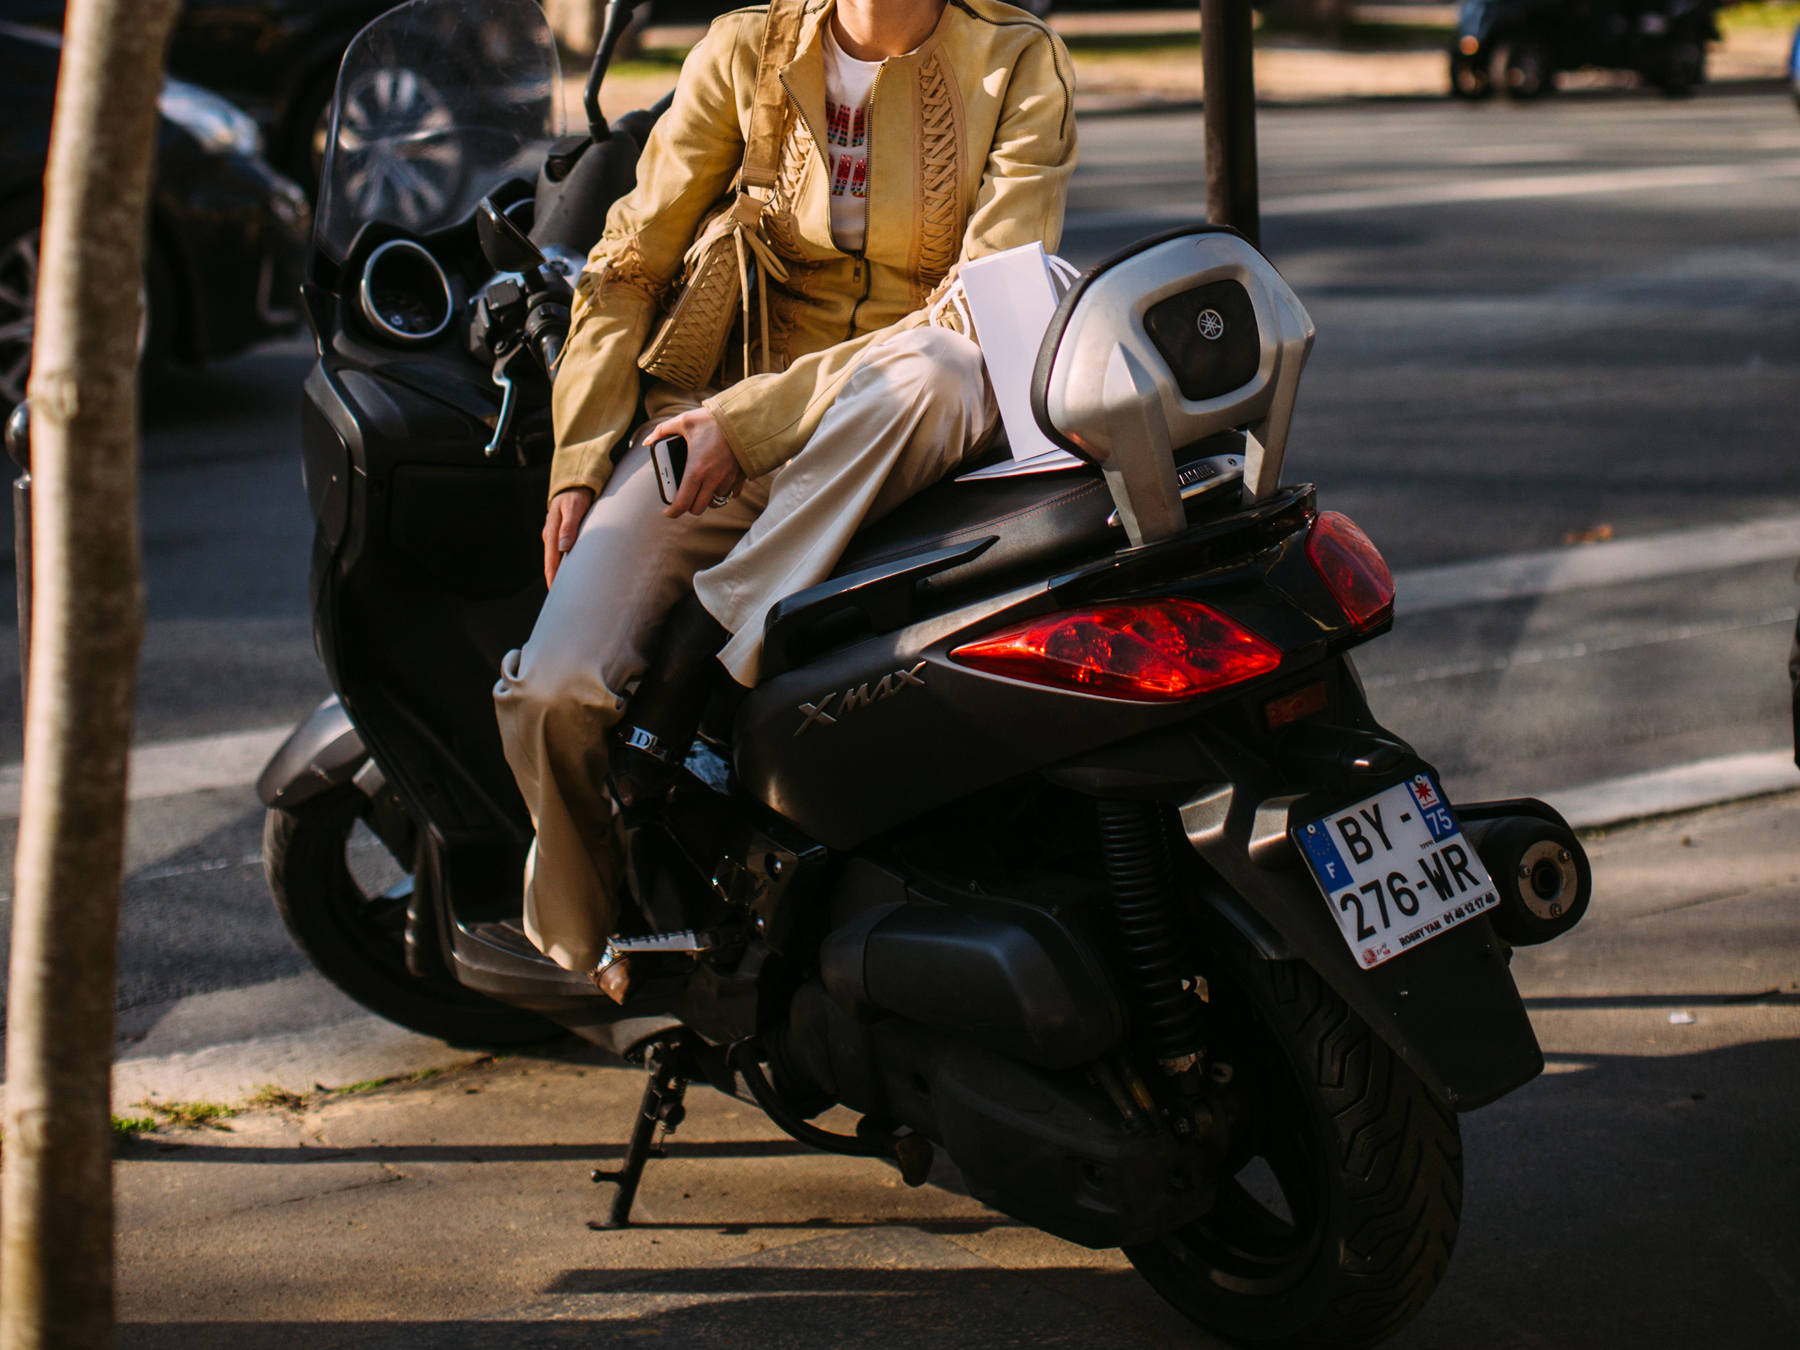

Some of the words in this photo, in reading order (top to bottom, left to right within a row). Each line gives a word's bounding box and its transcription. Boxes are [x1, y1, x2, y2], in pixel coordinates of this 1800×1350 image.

[1425, 807, 1453, 835] 75
[1325, 861, 1336, 879] F
[1340, 843, 1480, 942] 276-WR
